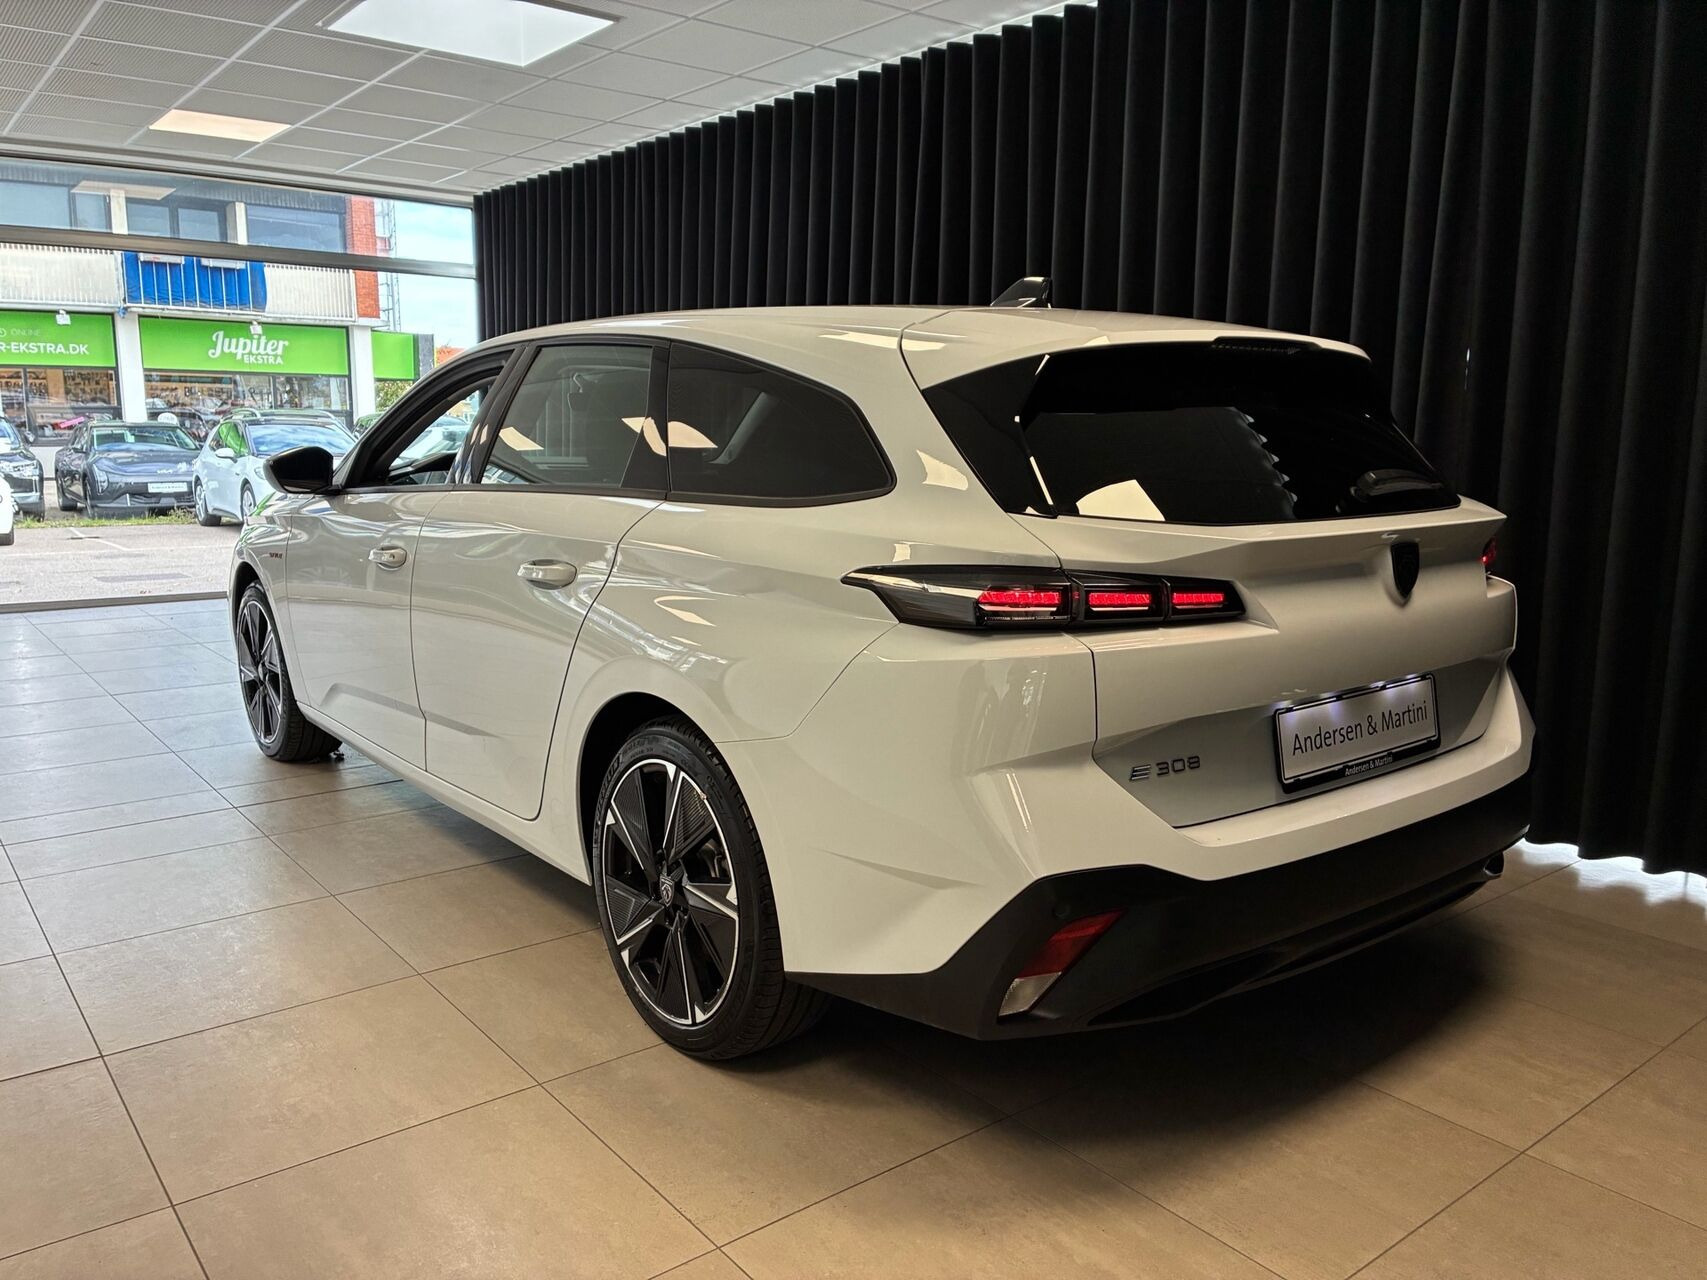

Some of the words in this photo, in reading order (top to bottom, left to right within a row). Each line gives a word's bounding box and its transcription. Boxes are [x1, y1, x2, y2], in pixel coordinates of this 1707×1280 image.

[208, 330, 289, 360] Jupiter
[243, 354, 283, 365] EKSTRA
[1292, 721, 1364, 756] Andersen
[1366, 714, 1378, 736] &
[1381, 700, 1428, 732] Martini
[1156, 755, 1201, 776] 308
[1344, 764, 1370, 777] Andersen
[1375, 754, 1393, 768] Martini
